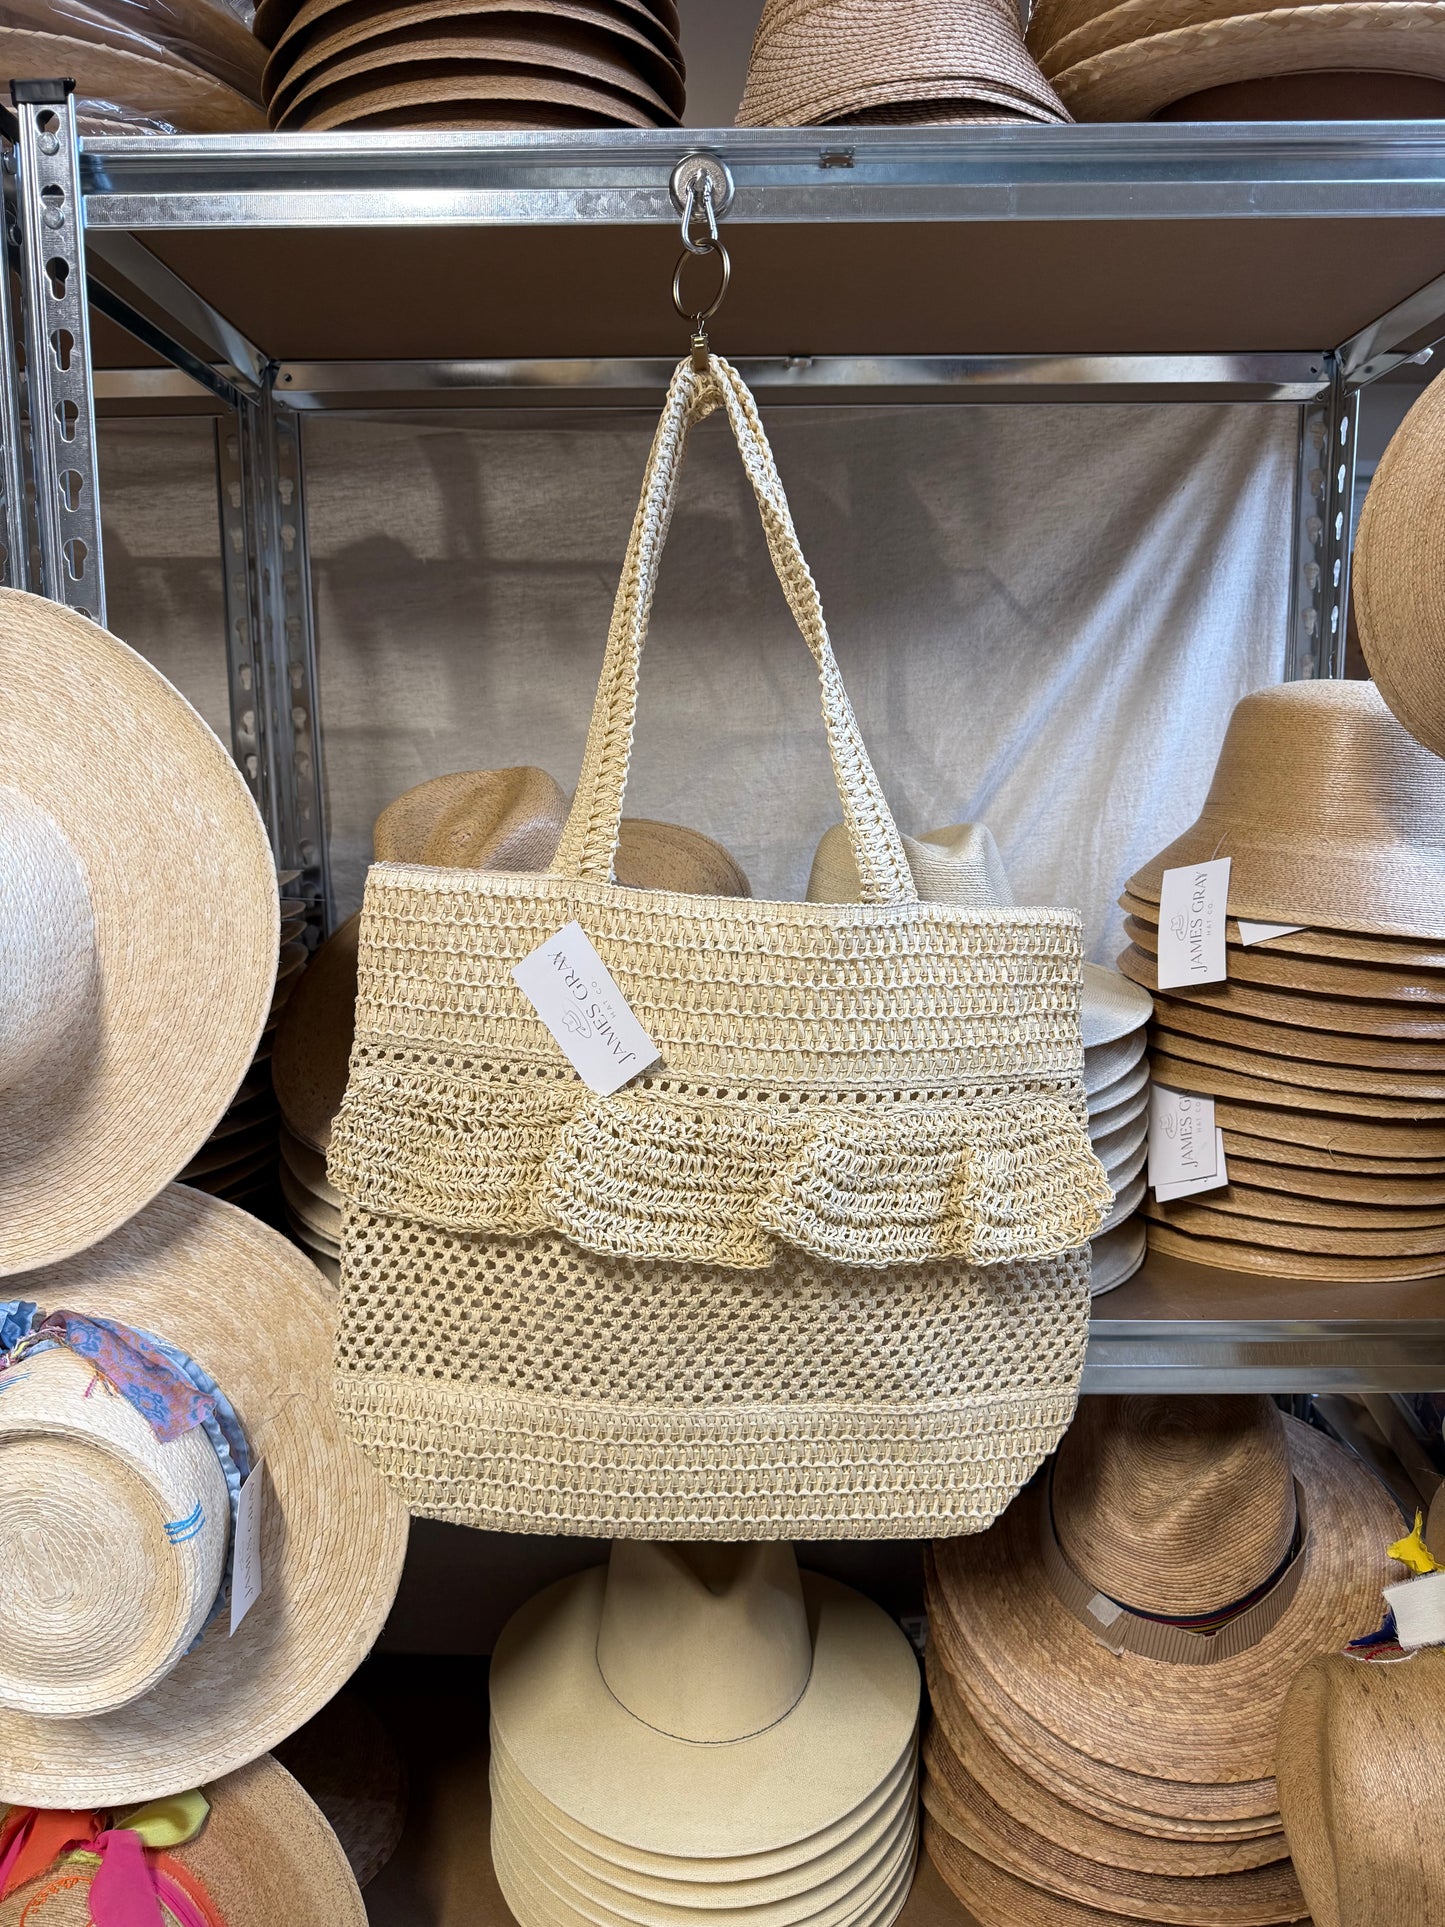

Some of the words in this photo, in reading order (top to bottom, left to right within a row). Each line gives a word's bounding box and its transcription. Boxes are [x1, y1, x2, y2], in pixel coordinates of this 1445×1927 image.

[1191, 872, 1208, 913] GRAY
[1190, 918, 1208, 973] JAMES
[547, 951, 589, 1001] GRAY
[585, 1003, 637, 1065] JAMES
[602, 1000, 617, 1019] HAT
[1180, 1116, 1198, 1168] JAMES
